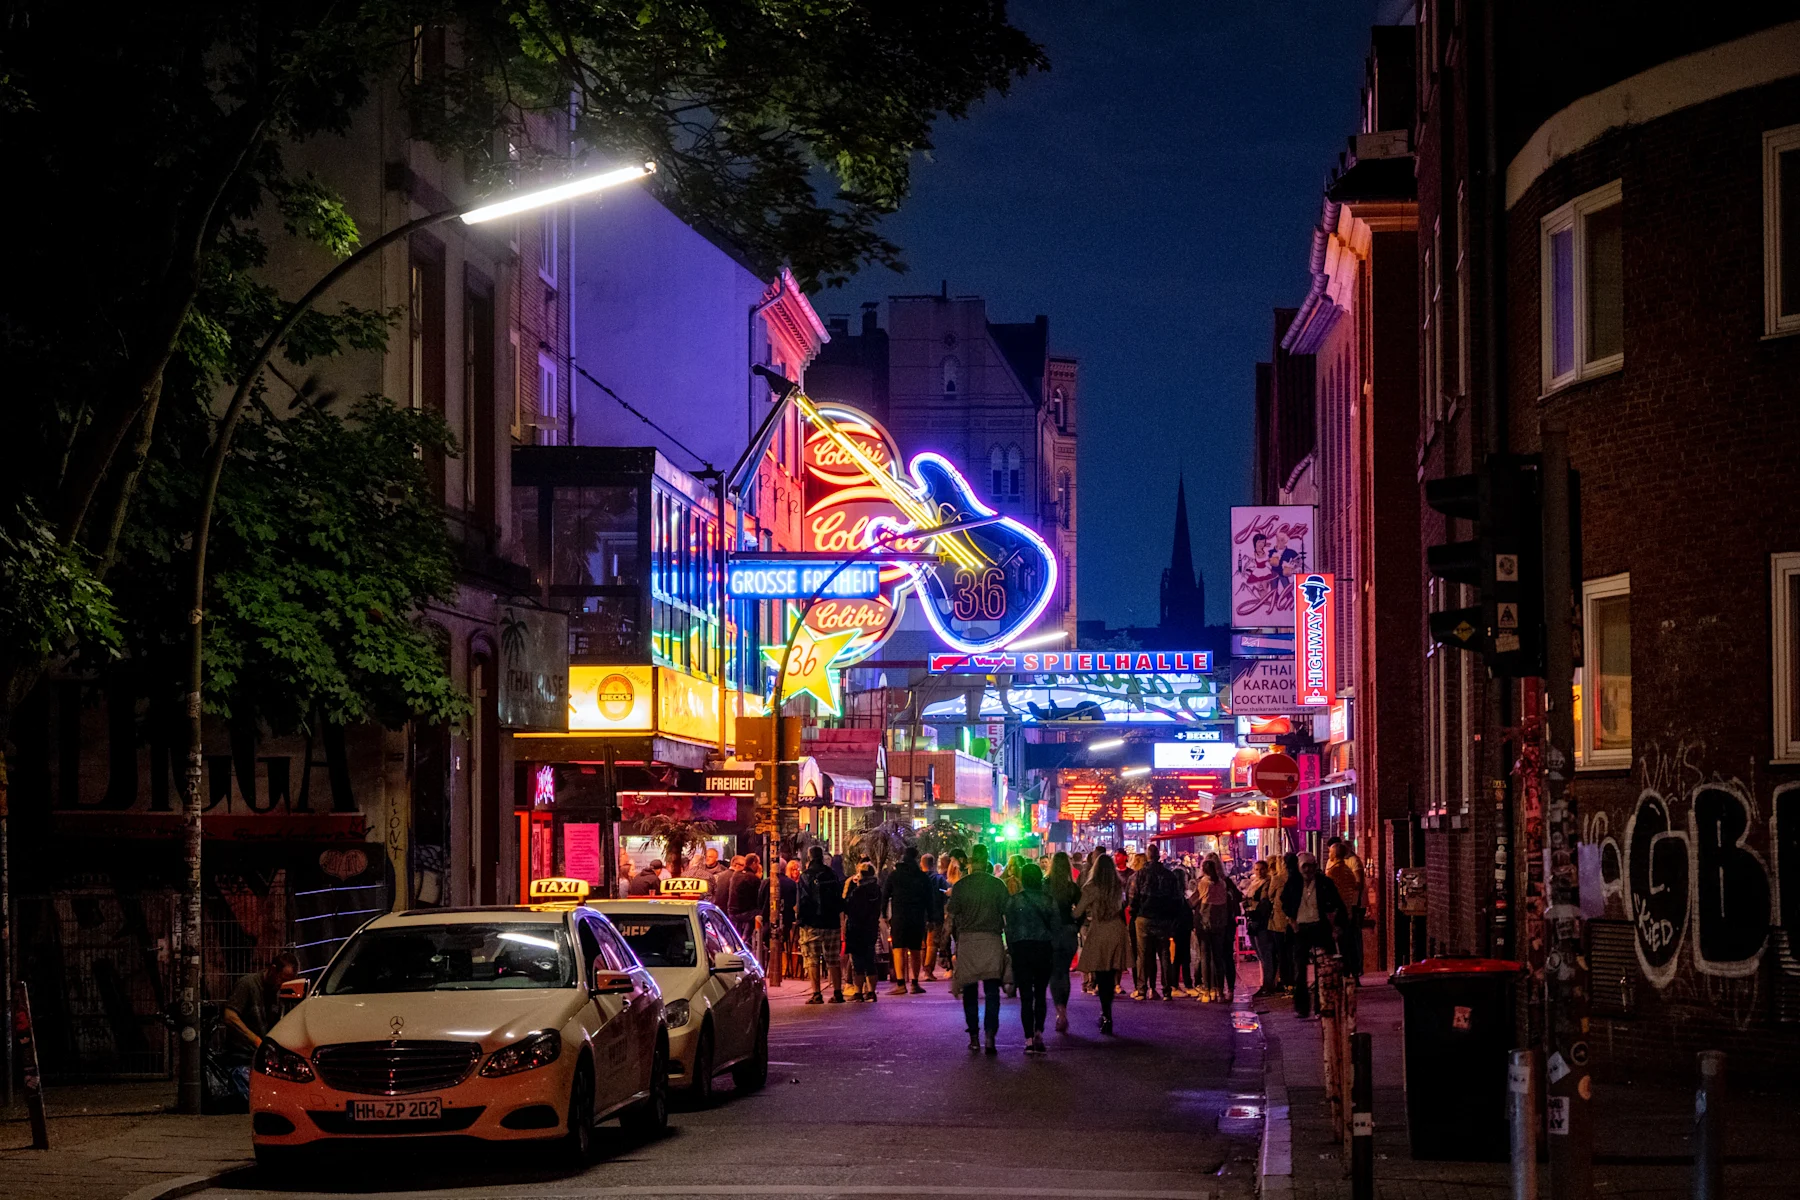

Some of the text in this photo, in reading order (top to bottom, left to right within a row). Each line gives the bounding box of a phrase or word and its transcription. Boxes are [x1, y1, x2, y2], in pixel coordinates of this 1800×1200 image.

[1234, 514, 1309, 545] Kiez
[731, 570, 796, 594] GROSSE
[954, 566, 1006, 621] 36
[815, 602, 886, 629] Colibri
[1308, 610, 1323, 687] HIGHWAY
[787, 645, 817, 677] 36
[1023, 653, 1208, 671] SPIELHALLE
[1260, 665, 1292, 676] THAI
[1243, 679, 1296, 690] KARAOK
[1234, 695, 1288, 705] COCKTAIL
[711, 777, 755, 791] FREIHEIT
[539, 881, 577, 893] TAXI
[667, 880, 698, 890] TAXI
[356, 1101, 439, 1119] HH ZP 202
